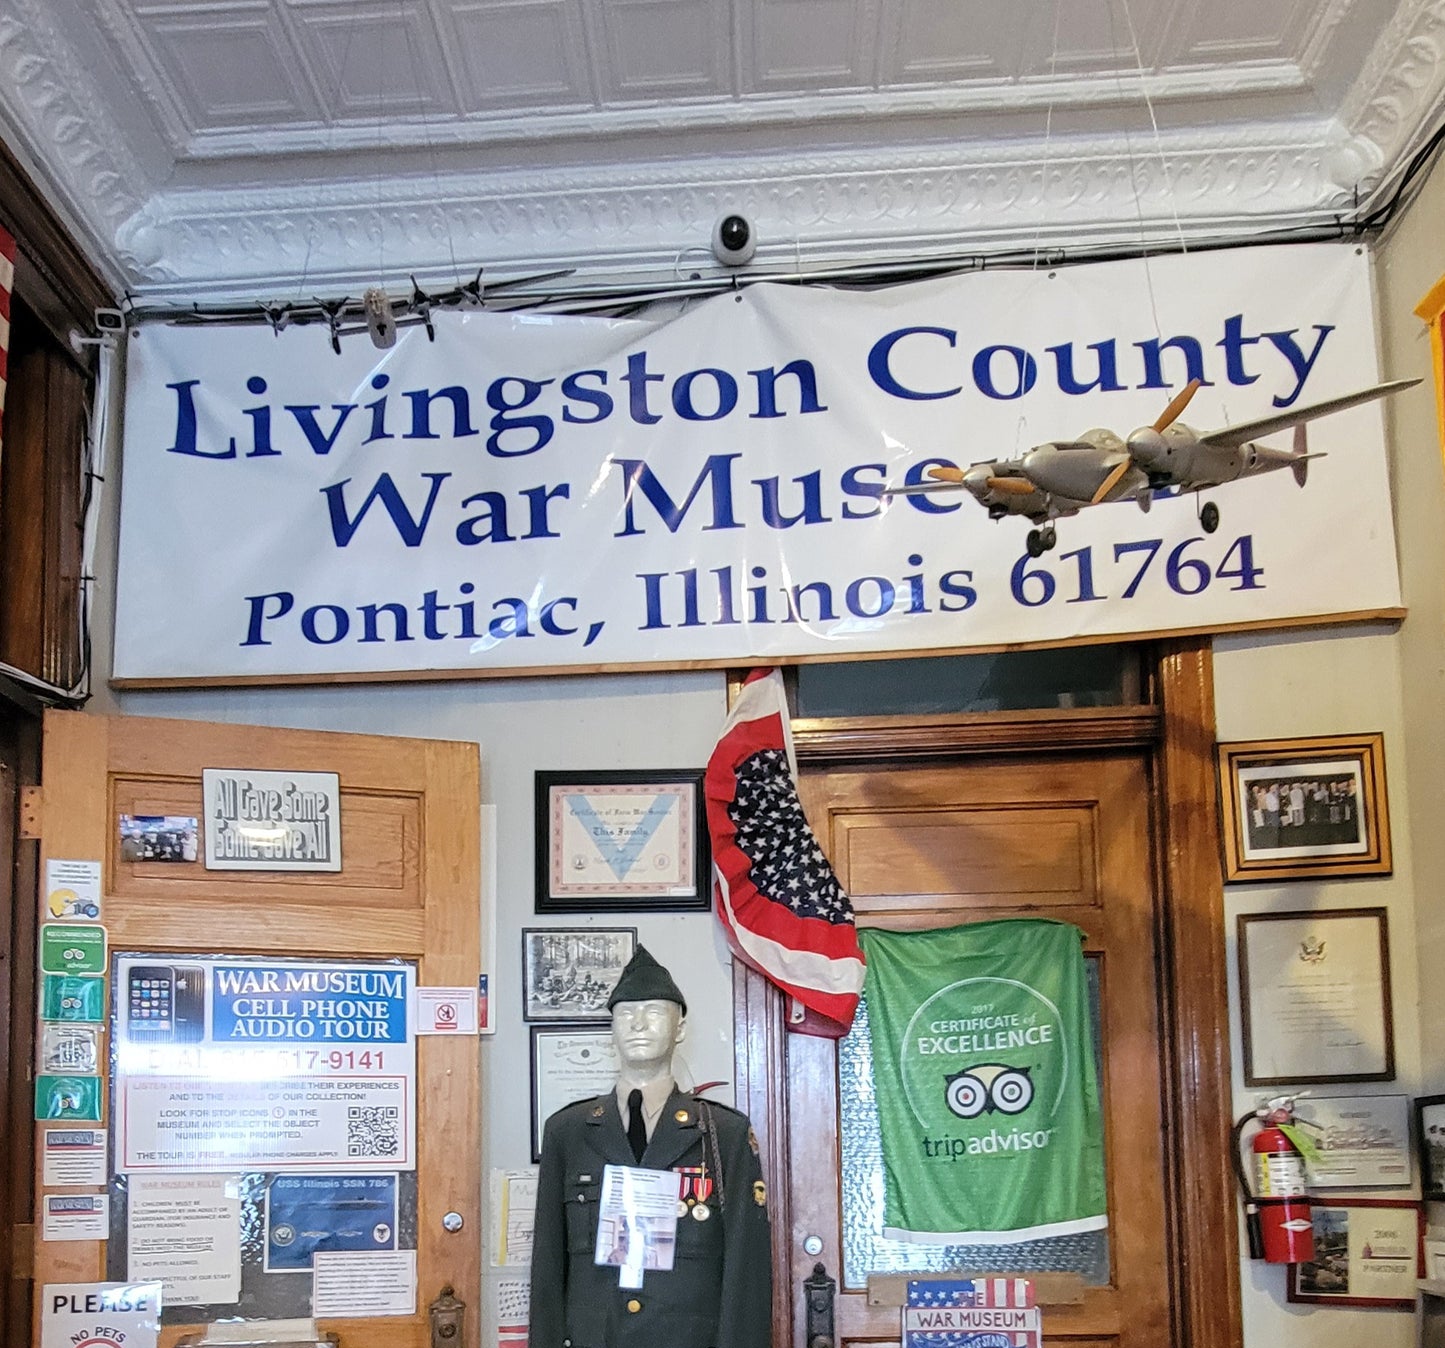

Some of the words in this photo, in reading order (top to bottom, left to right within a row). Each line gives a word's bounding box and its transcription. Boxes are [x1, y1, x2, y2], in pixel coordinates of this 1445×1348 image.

[165, 350, 828, 459] Livingston
[867, 313, 1337, 410] County
[319, 471, 571, 548] War
[612, 450, 1181, 539] Muse
[239, 582, 606, 648] Pontiac,
[635, 552, 978, 631] Illinois
[1009, 533, 1266, 608] 61764
[214, 778, 238, 820] All
[239, 779, 282, 821] Gave
[282, 781, 329, 822] Some
[305, 820, 331, 862] All
[216, 970, 281, 996] WAR
[284, 971, 404, 999] MUSEUM
[232, 999, 296, 1019] CELL
[302, 999, 390, 1019] PHONE
[970, 1003, 995, 1014] 2017
[230, 1019, 314, 1038] AUDIO
[319, 1019, 391, 1039] TOUR
[930, 1014, 1019, 1034] CERTIFICATE
[1022, 1013, 1037, 1025] of
[917, 1024, 1054, 1056] EXCELLENCE
[308, 1082, 335, 1090] THEIR
[337, 1082, 400, 1090] EXPERIENCES
[169, 1093, 190, 1101] AND
[191, 1093, 204, 1101] TO
[205, 1093, 225, 1101] THE
[305, 1092, 367, 1100] COLLECTION!
[160, 1110, 187, 1118] LOOK
[212, 1109, 238, 1117] STOP
[240, 1109, 269, 1117] ICONS
[288, 1109, 298, 1117] IN
[299, 1109, 318, 1117] THE
[157, 1121, 200, 1129] MUSEUM
[223, 1120, 260, 1128] SELECT
[263, 1120, 281, 1128] THE
[283, 1120, 321, 1128] OBJECT
[219, 1131, 247, 1139] WHEN
[249, 1131, 304, 1139] PROMPTED.
[922, 1127, 1058, 1162] tripadvisor
[136, 1151, 157, 1160] THE
[157, 1151, 184, 1160] TOUR
[276, 1179, 301, 1188] USS
[303, 1179, 340, 1188] Illinois
[342, 1179, 365, 1188] SSN
[368, 1179, 389, 1188] 786
[916, 1312, 955, 1328] WAR
[959, 1311, 1026, 1328] MUSEUM
[70, 1329, 89, 1345] NO
[94, 1326, 127, 1343] PETS
